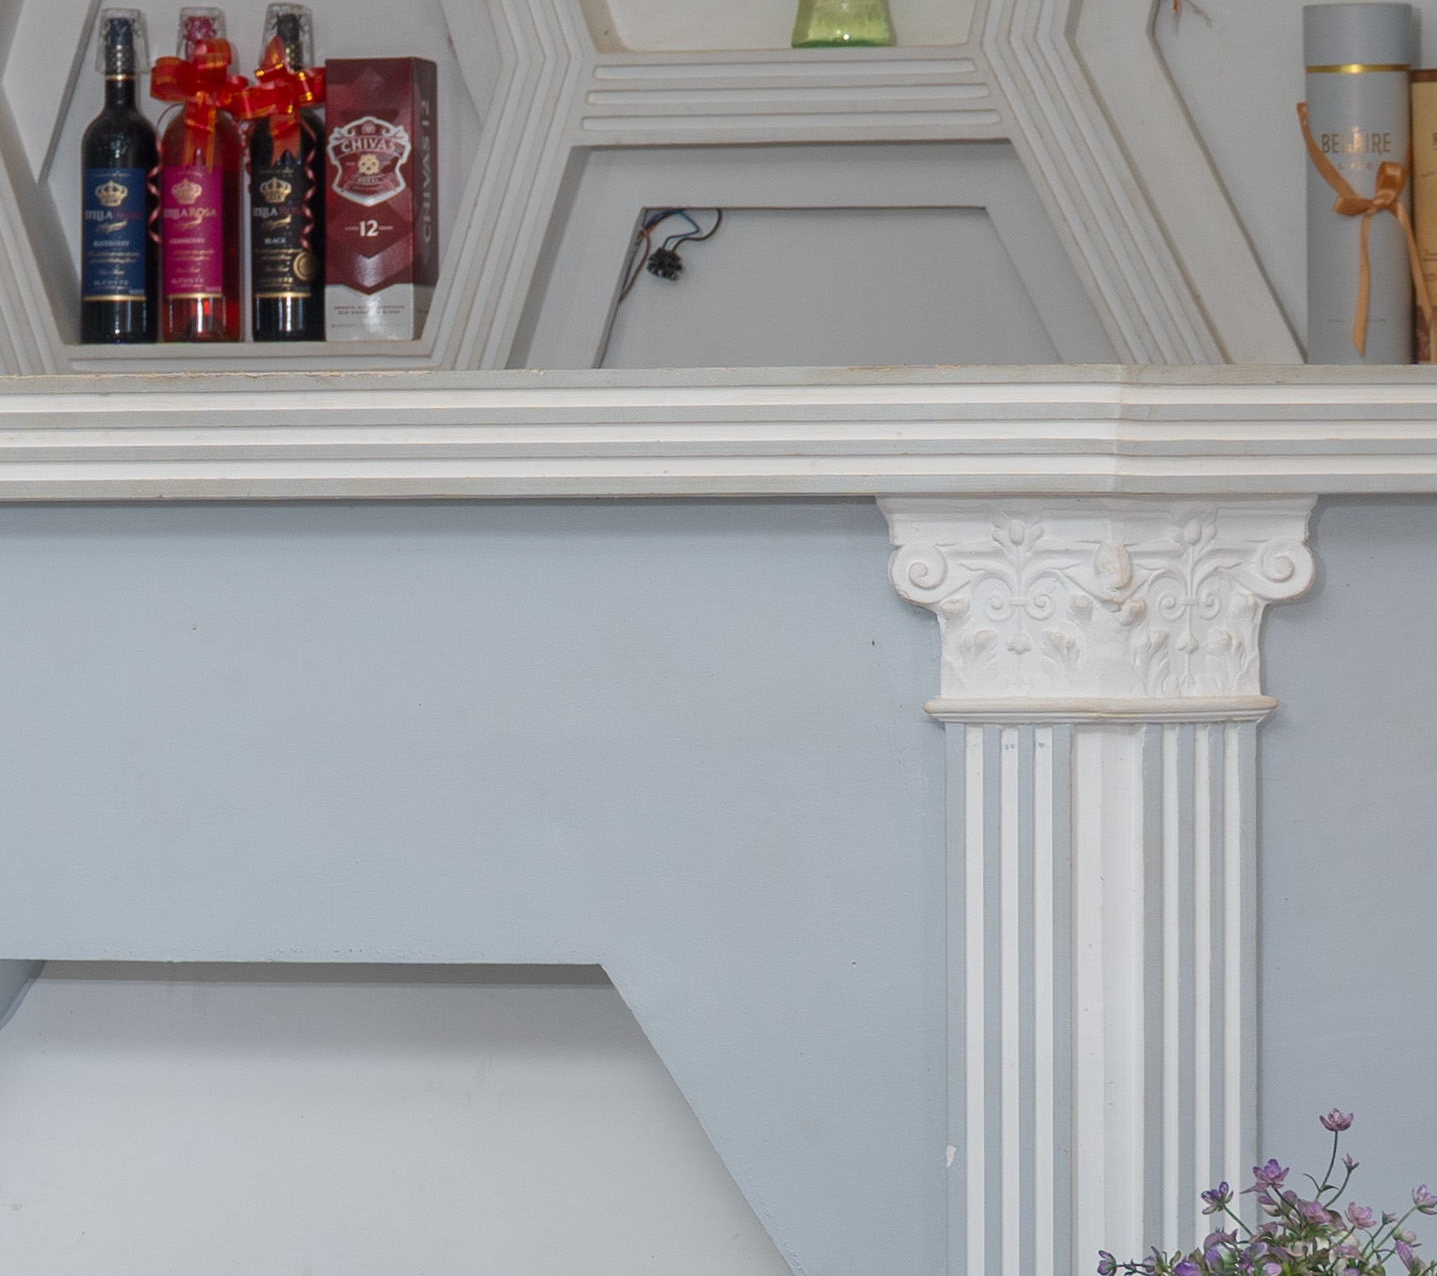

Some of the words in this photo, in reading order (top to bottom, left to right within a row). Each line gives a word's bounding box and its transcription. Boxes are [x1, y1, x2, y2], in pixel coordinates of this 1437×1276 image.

[341, 138, 397, 154] CHIVAS
[1321, 131, 1392, 155] BELAIRE
[359, 219, 380, 238] 12
